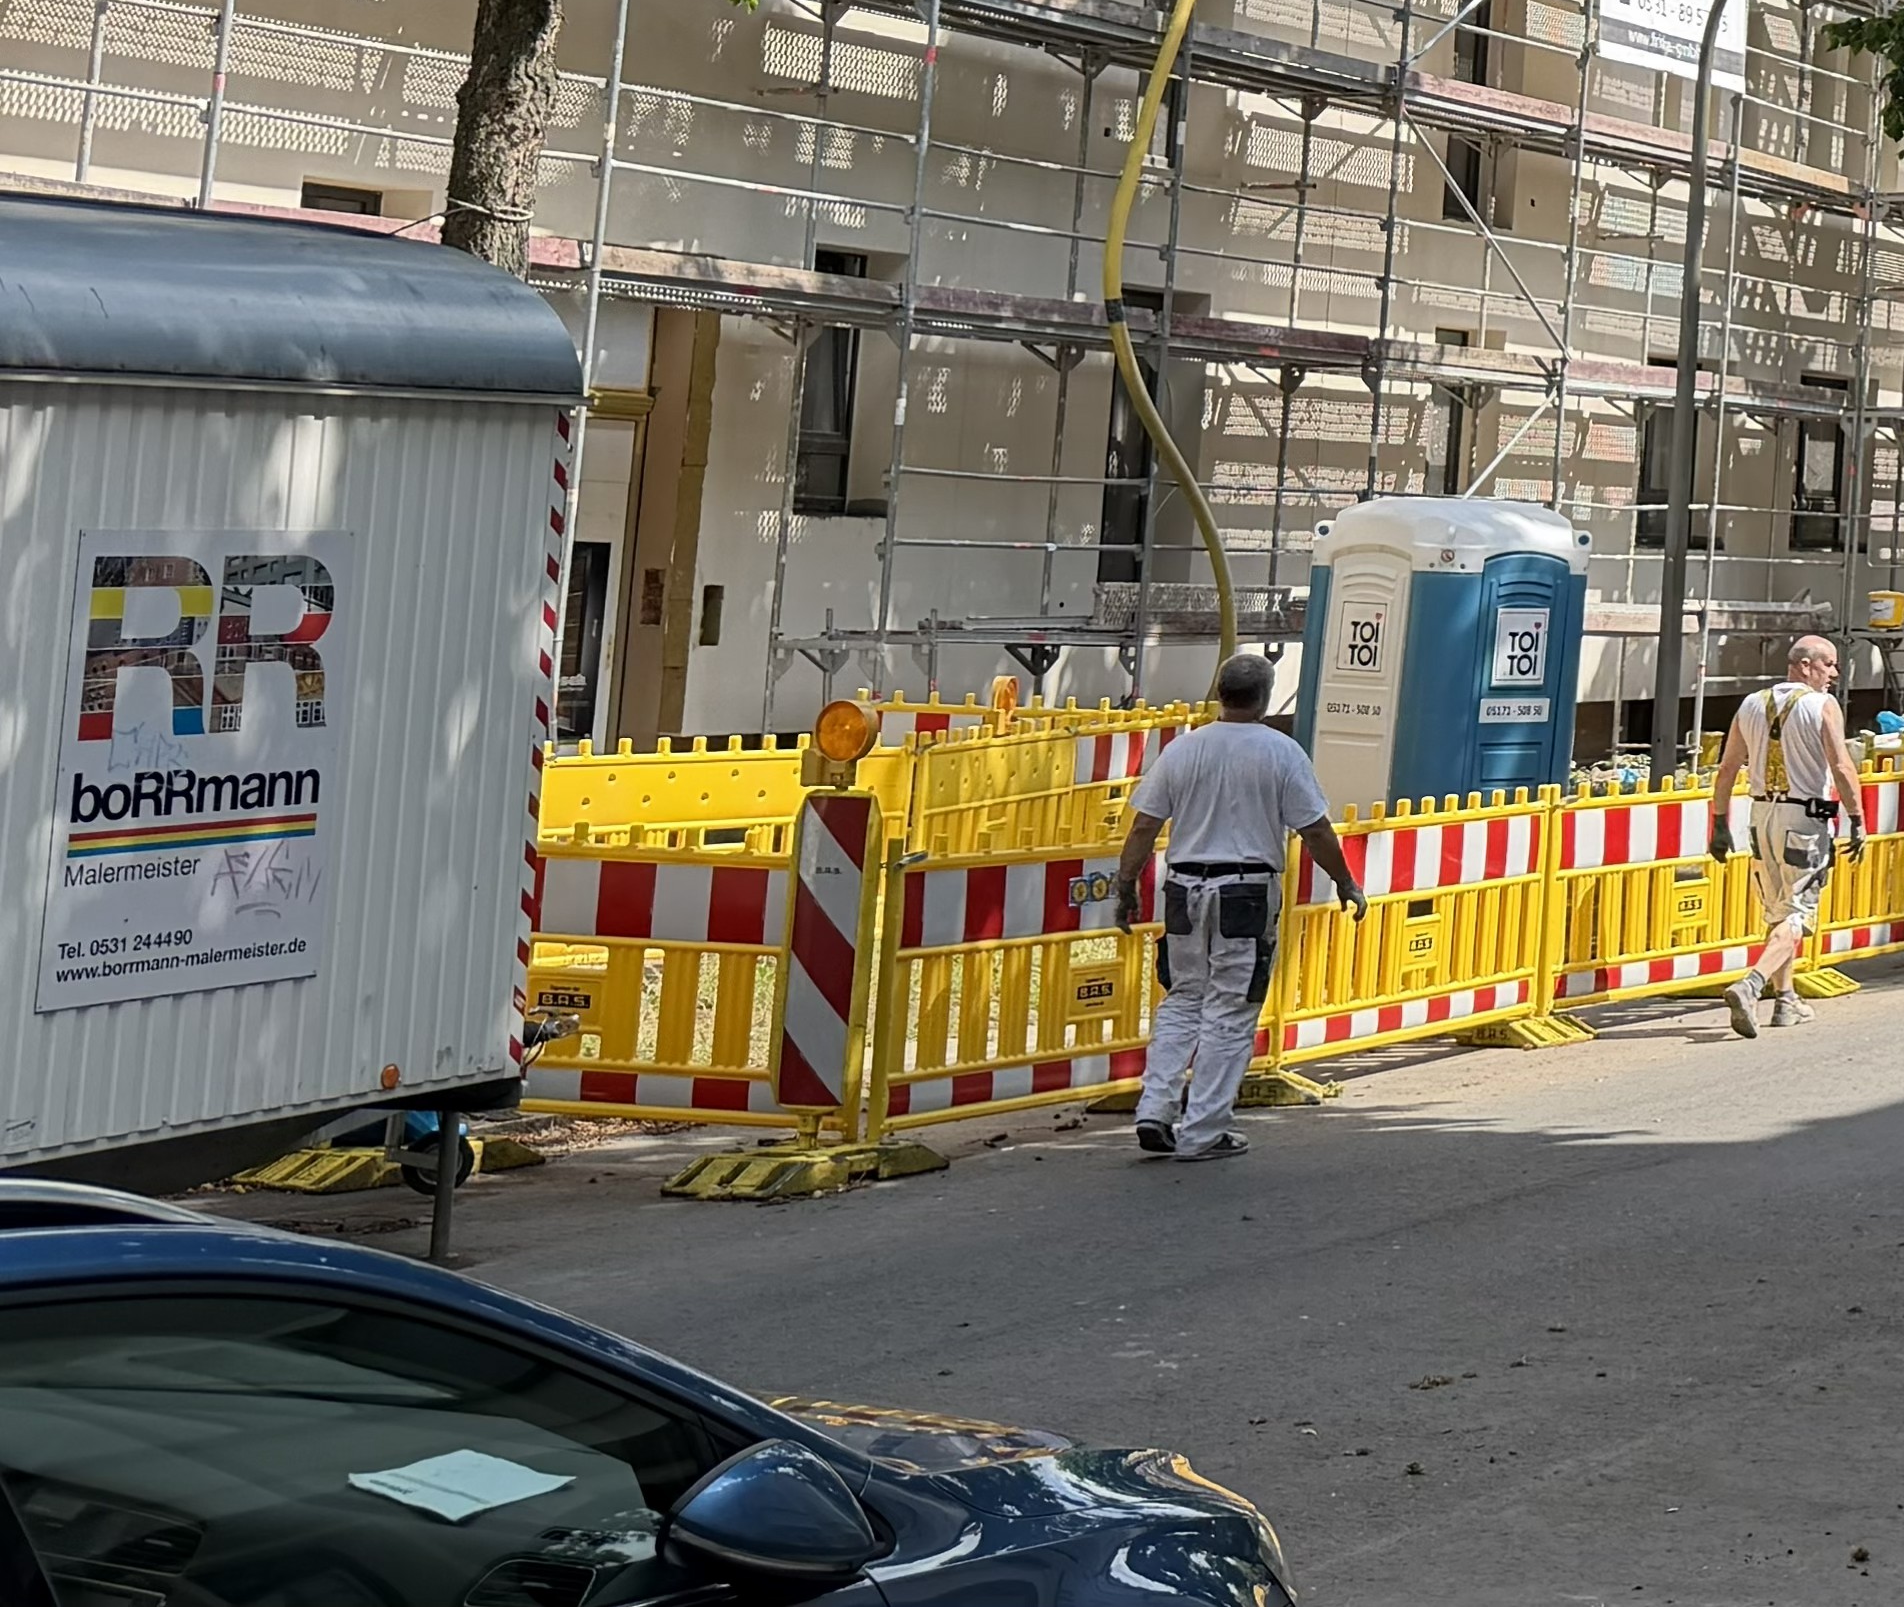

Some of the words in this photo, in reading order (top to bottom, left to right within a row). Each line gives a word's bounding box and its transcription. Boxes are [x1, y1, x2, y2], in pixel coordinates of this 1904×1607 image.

[1351, 620, 1380, 644] TOI
[1508, 630, 1540, 654] TOI
[78, 555, 335, 742] RR
[1348, 644, 1378, 667] TOI
[1506, 654, 1538, 676] TOI
[70, 768, 321, 824] boRRmann
[64, 857, 201, 888] Malermeister
[57, 941, 86, 961] Tel.
[89, 937, 127, 957] 0531
[132, 929, 194, 952] 244490
[56, 937, 308, 983] www.borrmann-malermeister.de
[541, 993, 589, 1008] B.A.S.
